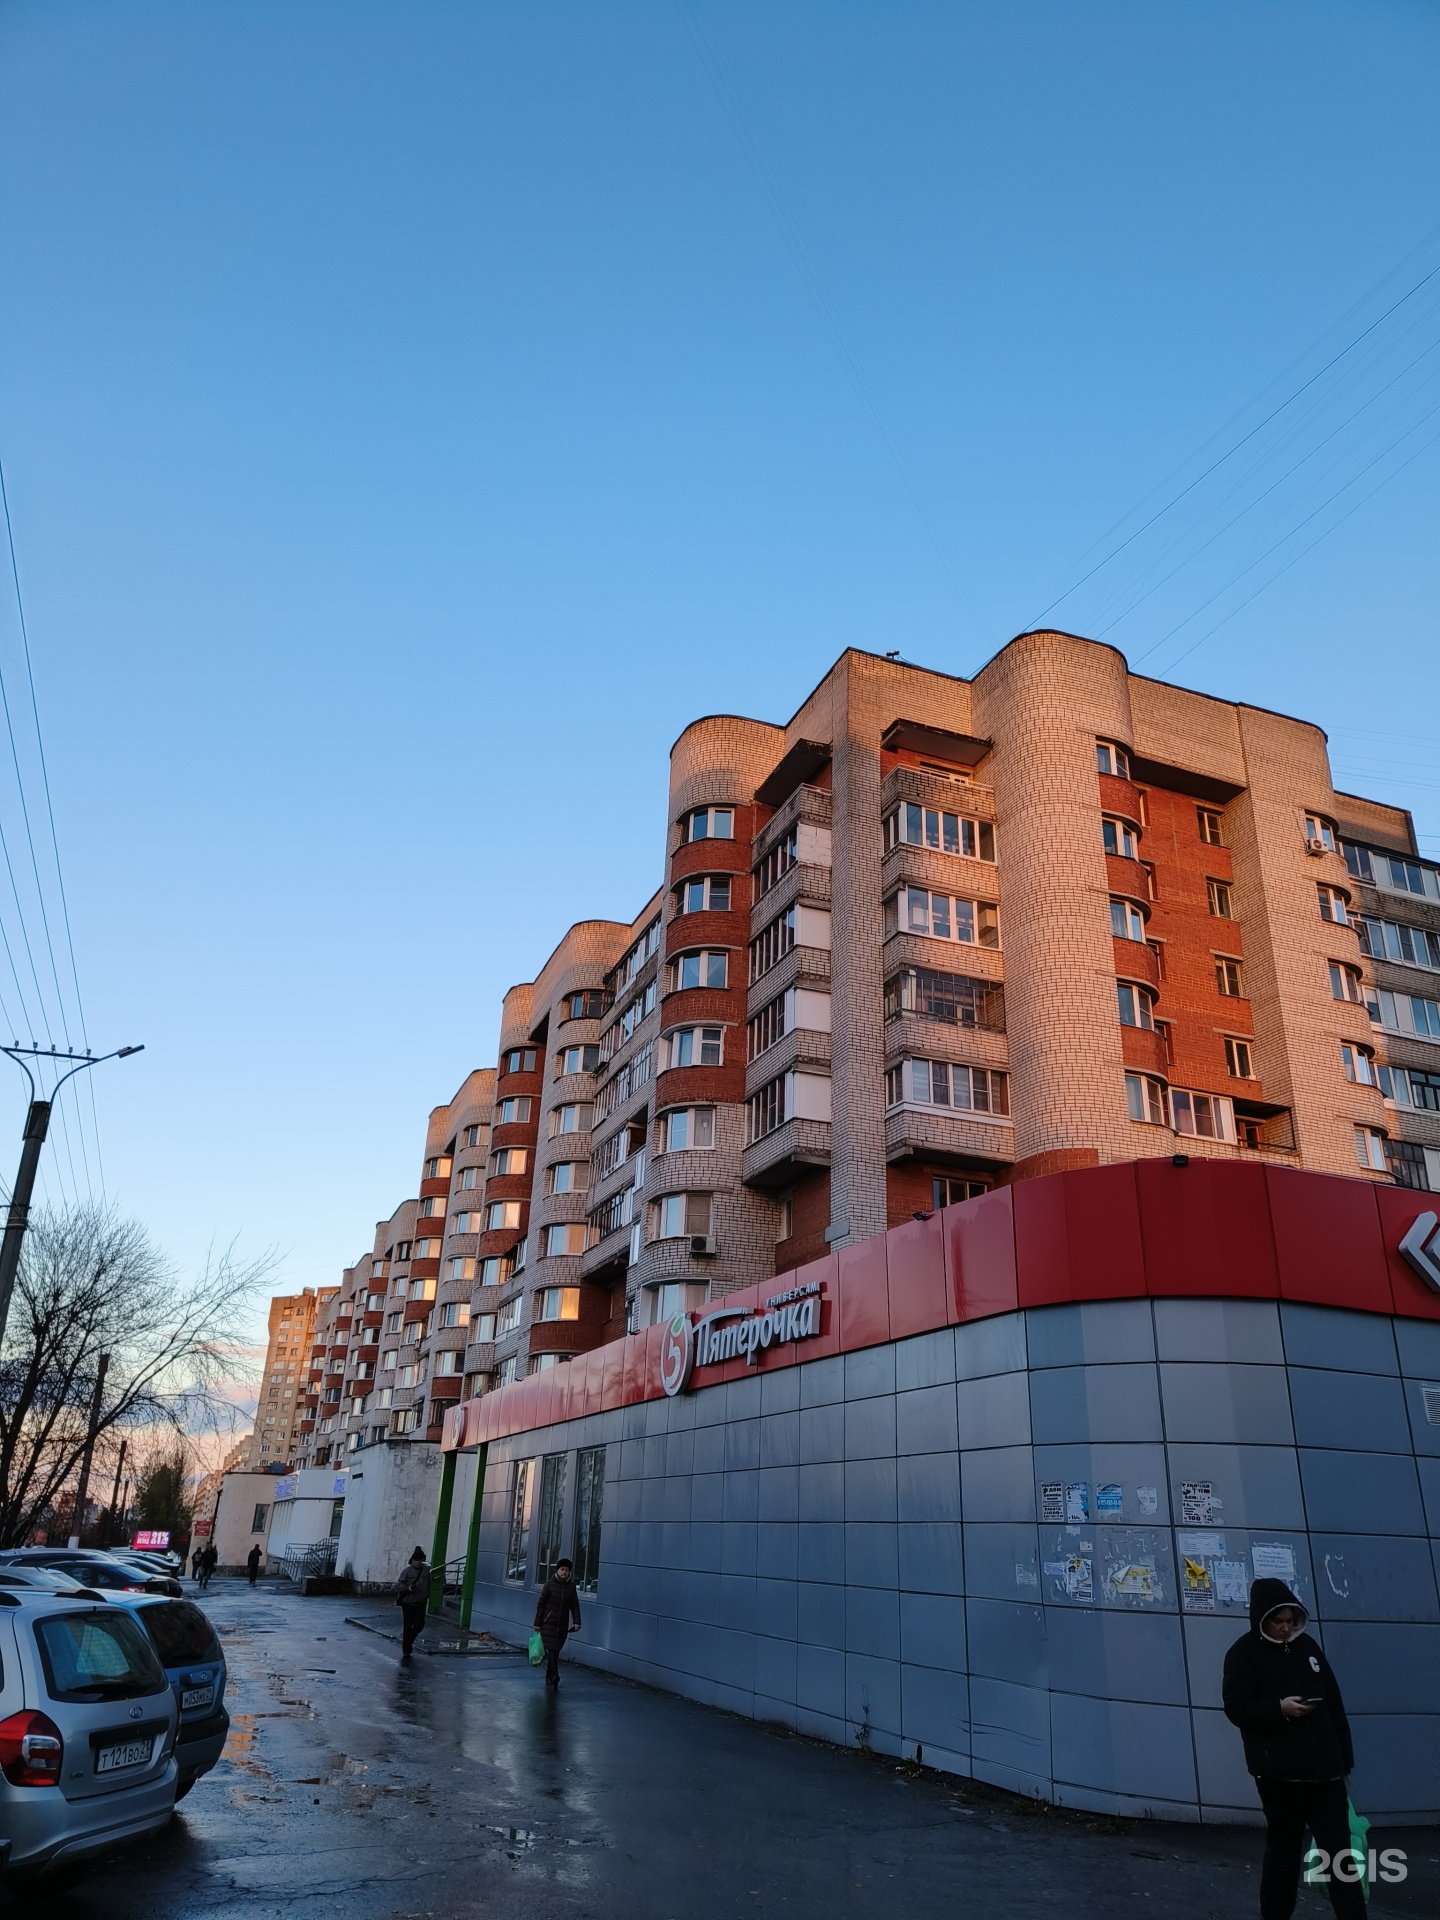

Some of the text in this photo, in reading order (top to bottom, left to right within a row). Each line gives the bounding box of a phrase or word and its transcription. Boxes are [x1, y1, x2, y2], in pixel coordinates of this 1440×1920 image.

[766, 1281, 820, 1308] УНИВЕРСАМ
[692, 1298, 822, 1366] Пятерочка
[1308, 1656, 1321, 1673] C
